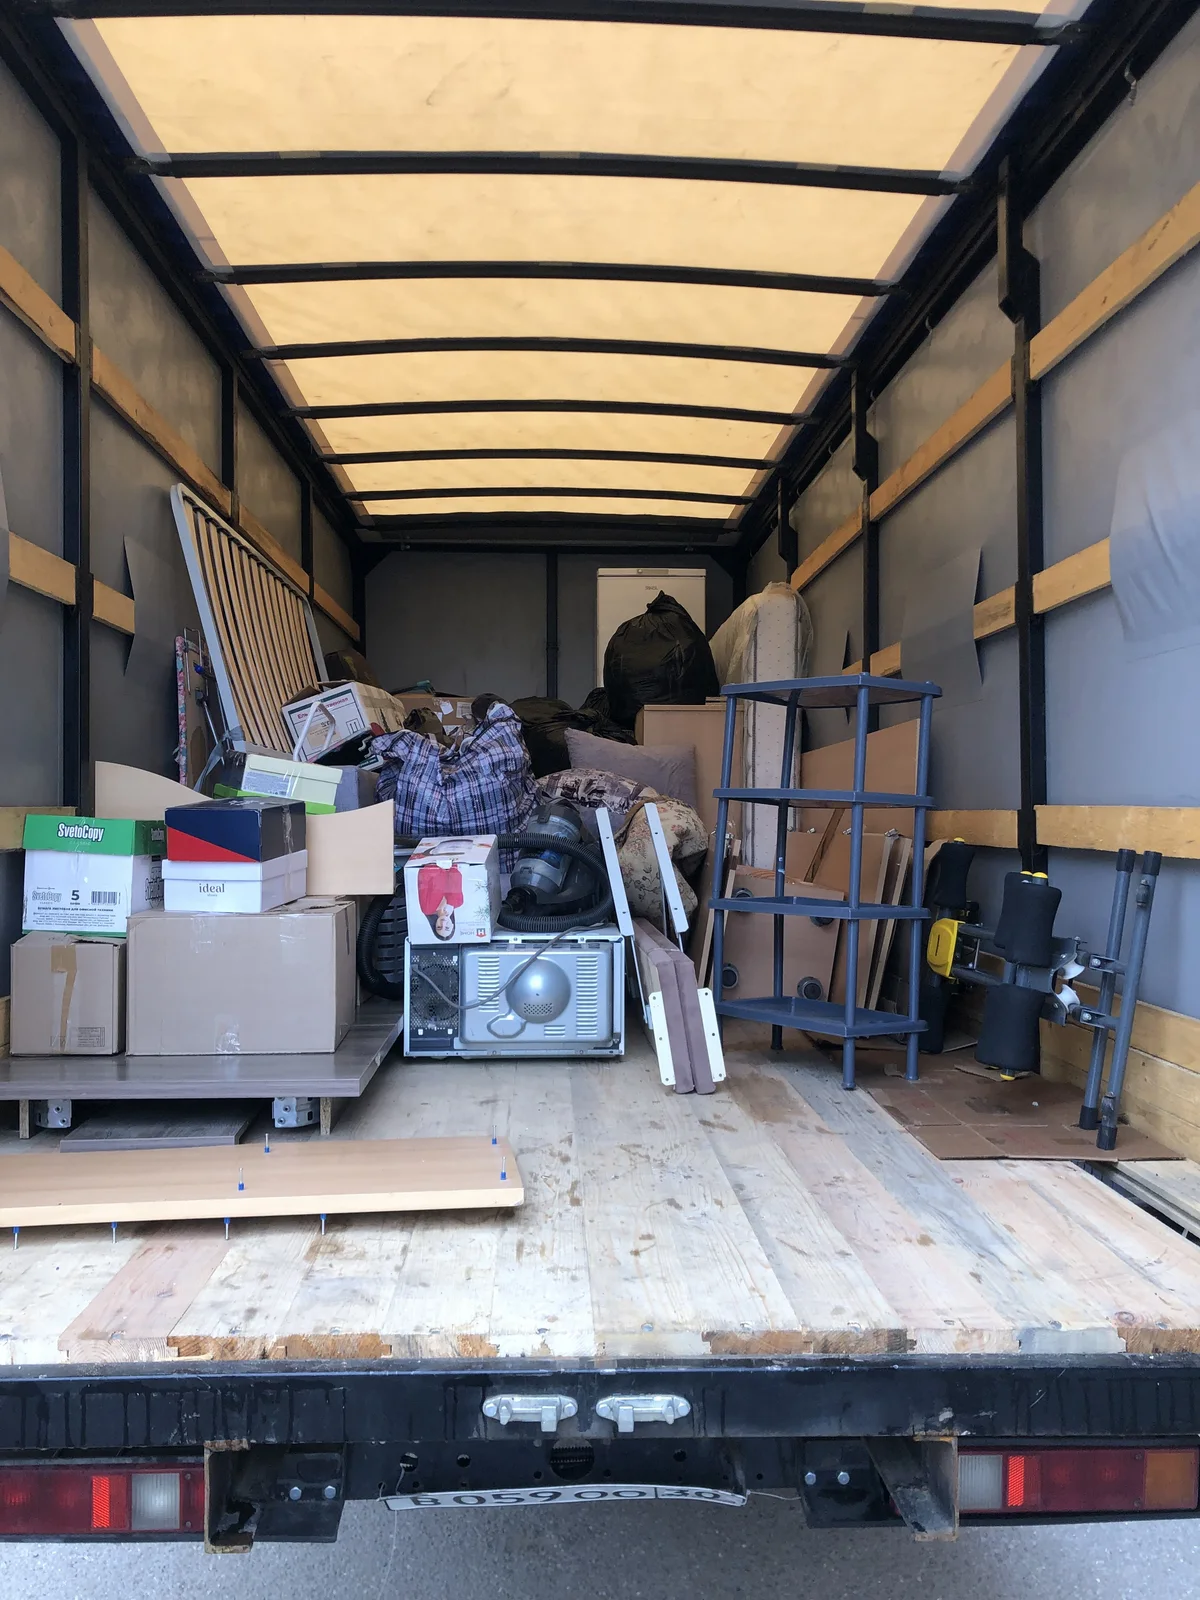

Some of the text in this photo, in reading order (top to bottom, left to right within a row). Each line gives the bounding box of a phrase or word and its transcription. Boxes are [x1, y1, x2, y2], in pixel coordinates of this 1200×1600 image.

[57, 823, 104, 842] SvetoCopy
[199, 883, 225, 893] ideal
[32, 890, 62, 902] SvetoCopy
[71, 890, 80, 901] 5
